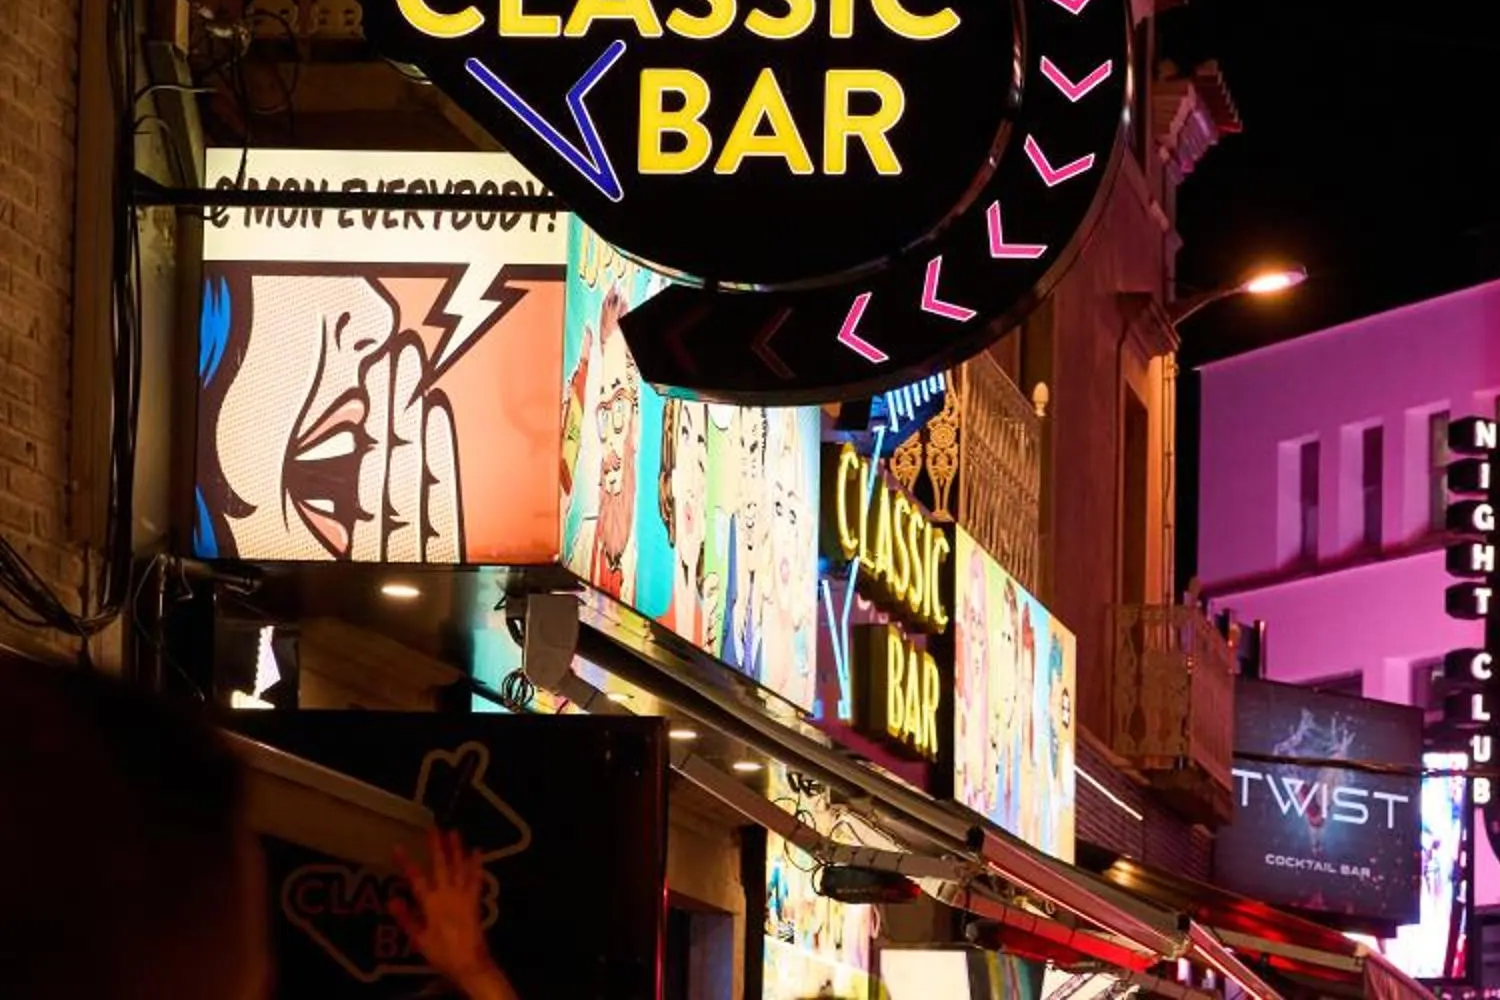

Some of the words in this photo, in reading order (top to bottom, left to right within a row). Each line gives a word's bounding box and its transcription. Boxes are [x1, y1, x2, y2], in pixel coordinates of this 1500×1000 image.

[637, 67, 905, 175] BAR
[836, 443, 951, 632] CLASSIC
[1472, 420, 1497, 616] NIGHT
[886, 626, 941, 763] BAR
[1470, 651, 1493, 806] CLUB
[1231, 768, 1409, 829] TWIST
[1264, 853, 1337, 874] COCKTAIL
[1339, 864, 1371, 877] BAR
